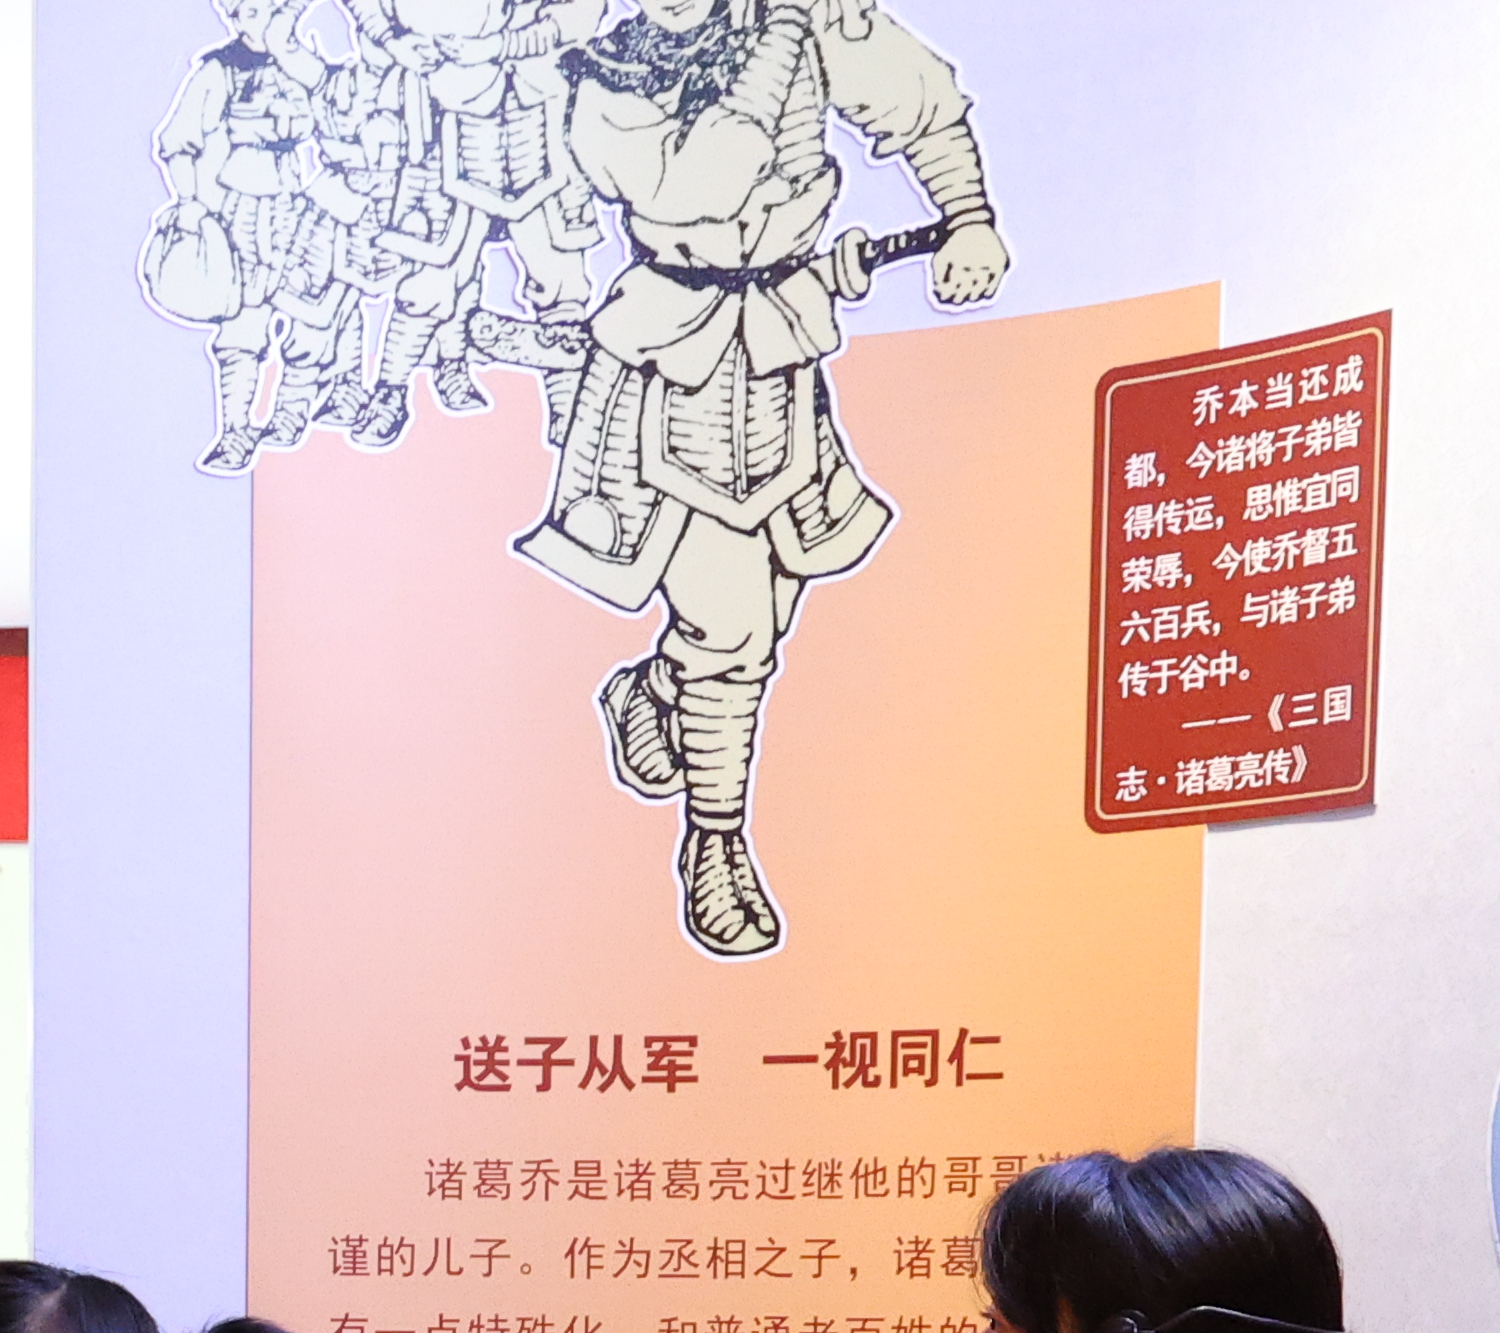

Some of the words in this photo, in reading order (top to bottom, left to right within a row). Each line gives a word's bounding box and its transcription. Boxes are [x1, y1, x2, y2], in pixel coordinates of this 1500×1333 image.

[1193, 354, 1365, 427] 乔本当还成
[1123, 409, 1363, 490] 都，今诸将子弟皆
[1122, 465, 1361, 543] 得传运，思惟宜同
[1121, 522, 1359, 594] 荣辱，今使乔督五
[1119, 574, 1357, 647] 六百兵，与诸子弟
[1117, 649, 1252, 699] 传于谷中。
[453, 1033, 699, 1094] 送子从军
[761, 1026, 1006, 1091] 一视同仁
